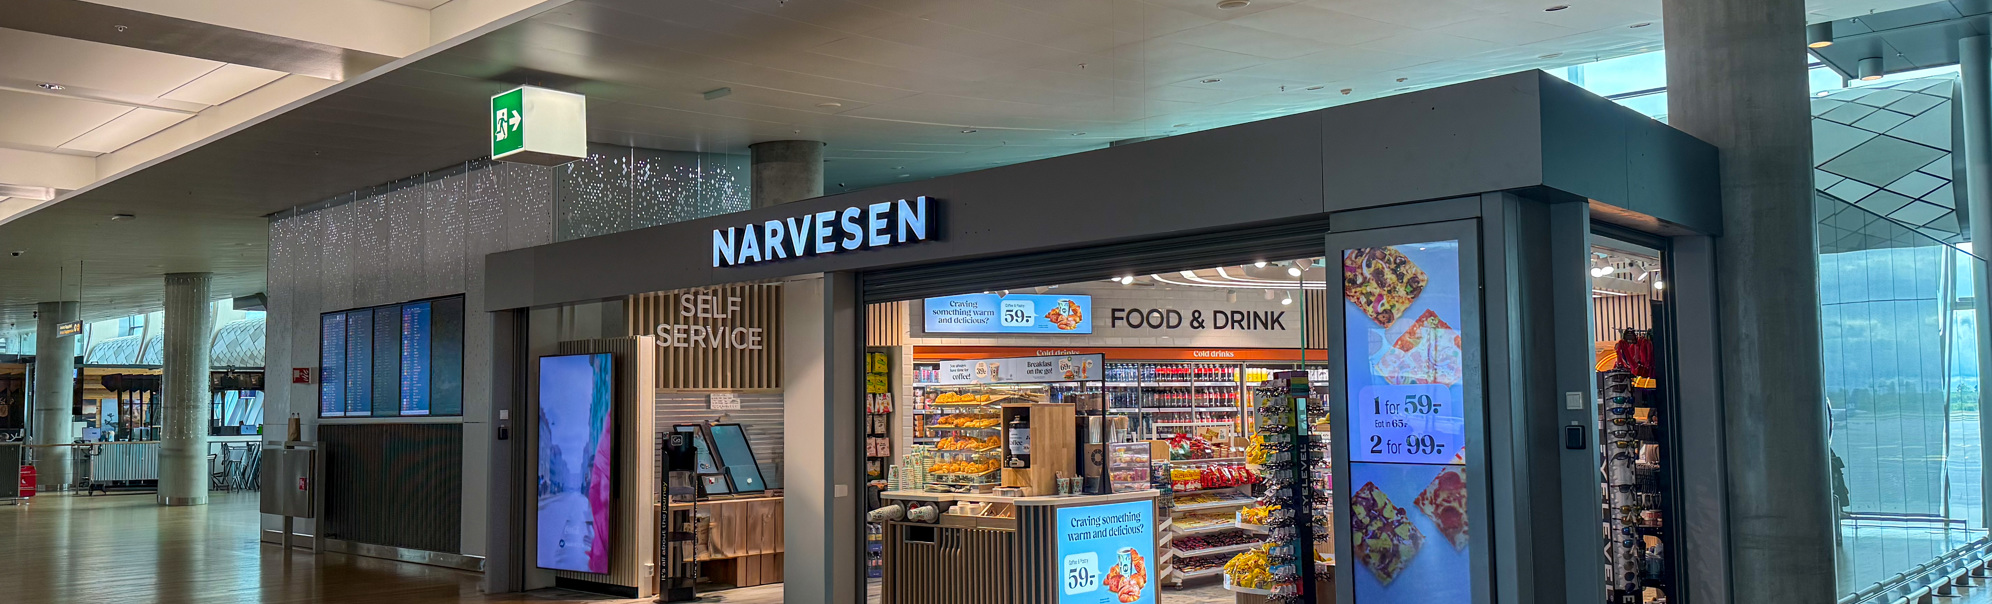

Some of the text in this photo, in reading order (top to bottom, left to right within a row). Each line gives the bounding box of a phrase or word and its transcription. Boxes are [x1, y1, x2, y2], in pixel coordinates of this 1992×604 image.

[712, 195, 926, 268] NARVESEN
[680, 293, 742, 319] SELF
[932, 308, 972, 317] something
[949, 300, 978, 308] Craving
[1111, 308, 1286, 331] FOOD & DRINK
[656, 323, 763, 350] SERVICE
[1374, 396, 1380, 414] 1
[1385, 400, 1400, 415] for
[1374, 419, 1384, 428] Eat
[1385, 419, 1391, 428] in
[1370, 434, 1382, 454] 2
[1386, 439, 1402, 454] for
[1300, 443, 1310, 514] EYELEVEL
[1070, 511, 1142, 528] Craving something
[1067, 523, 1144, 542] warm and delicious?
